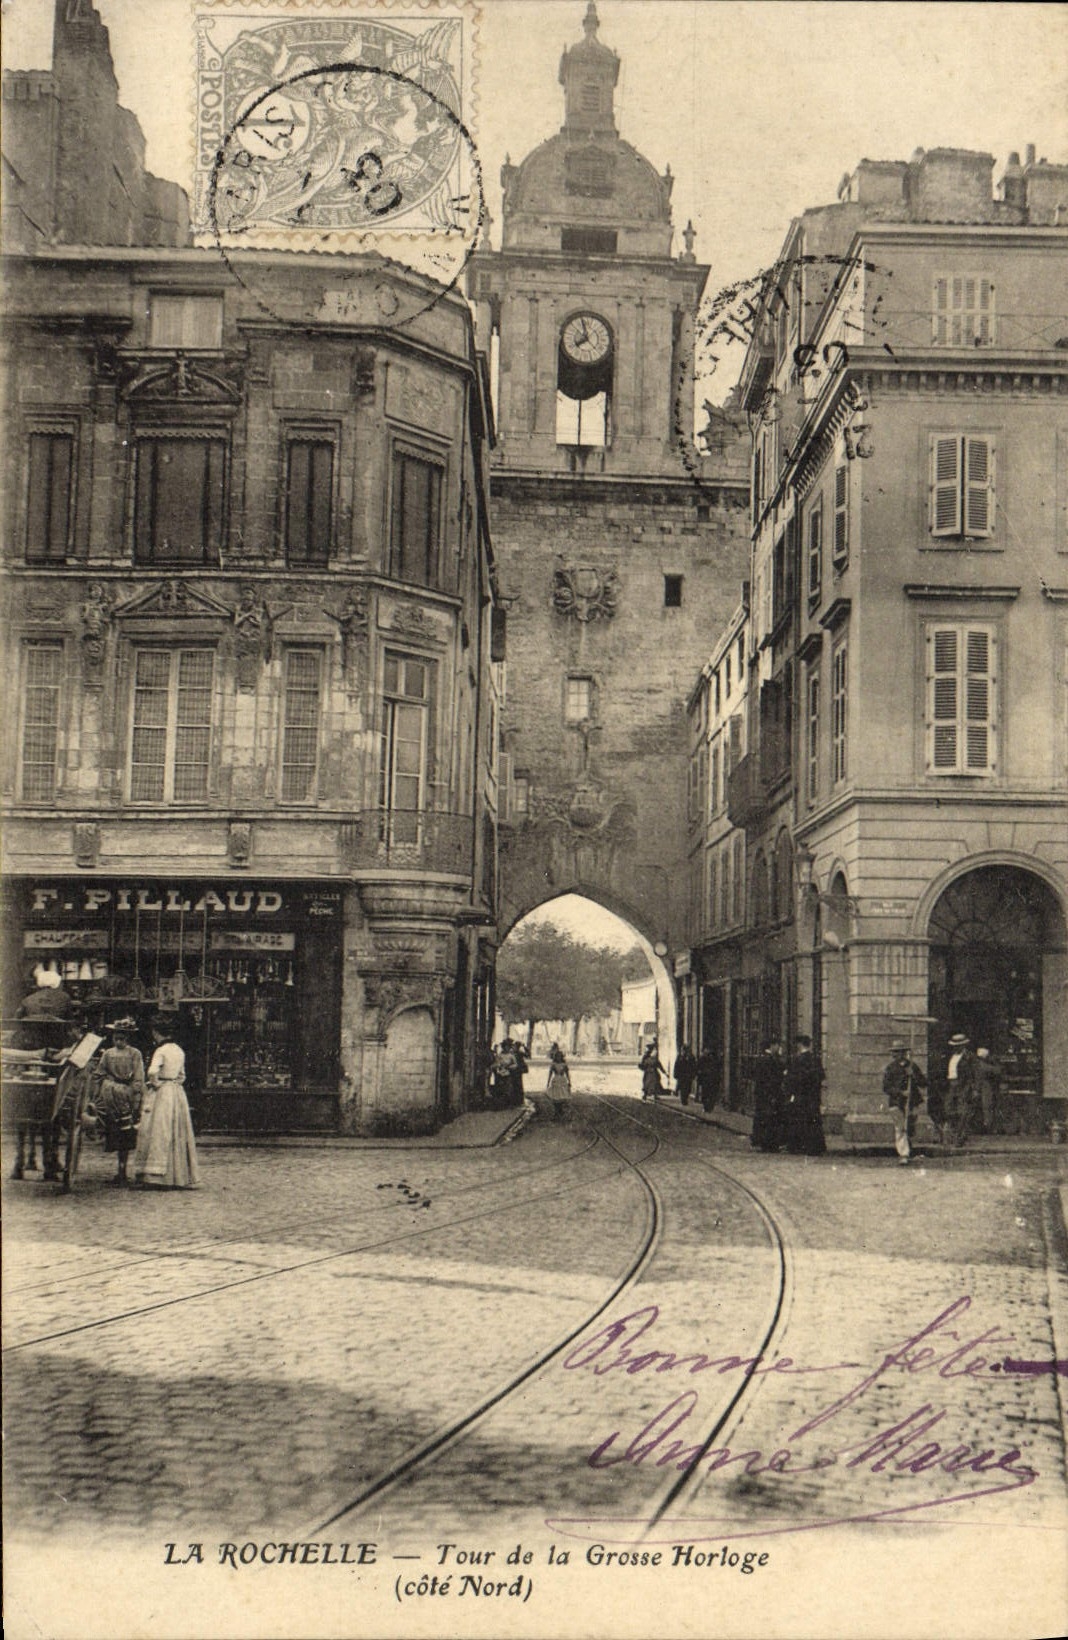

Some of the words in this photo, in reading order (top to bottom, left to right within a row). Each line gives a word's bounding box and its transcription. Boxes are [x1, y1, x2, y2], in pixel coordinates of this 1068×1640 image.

[200, 73, 222, 167] POSTES
[31, 889, 73, 910] F.
[83, 889, 283, 912] PILLAUD
[563, 1306, 800, 1377] Bonne
